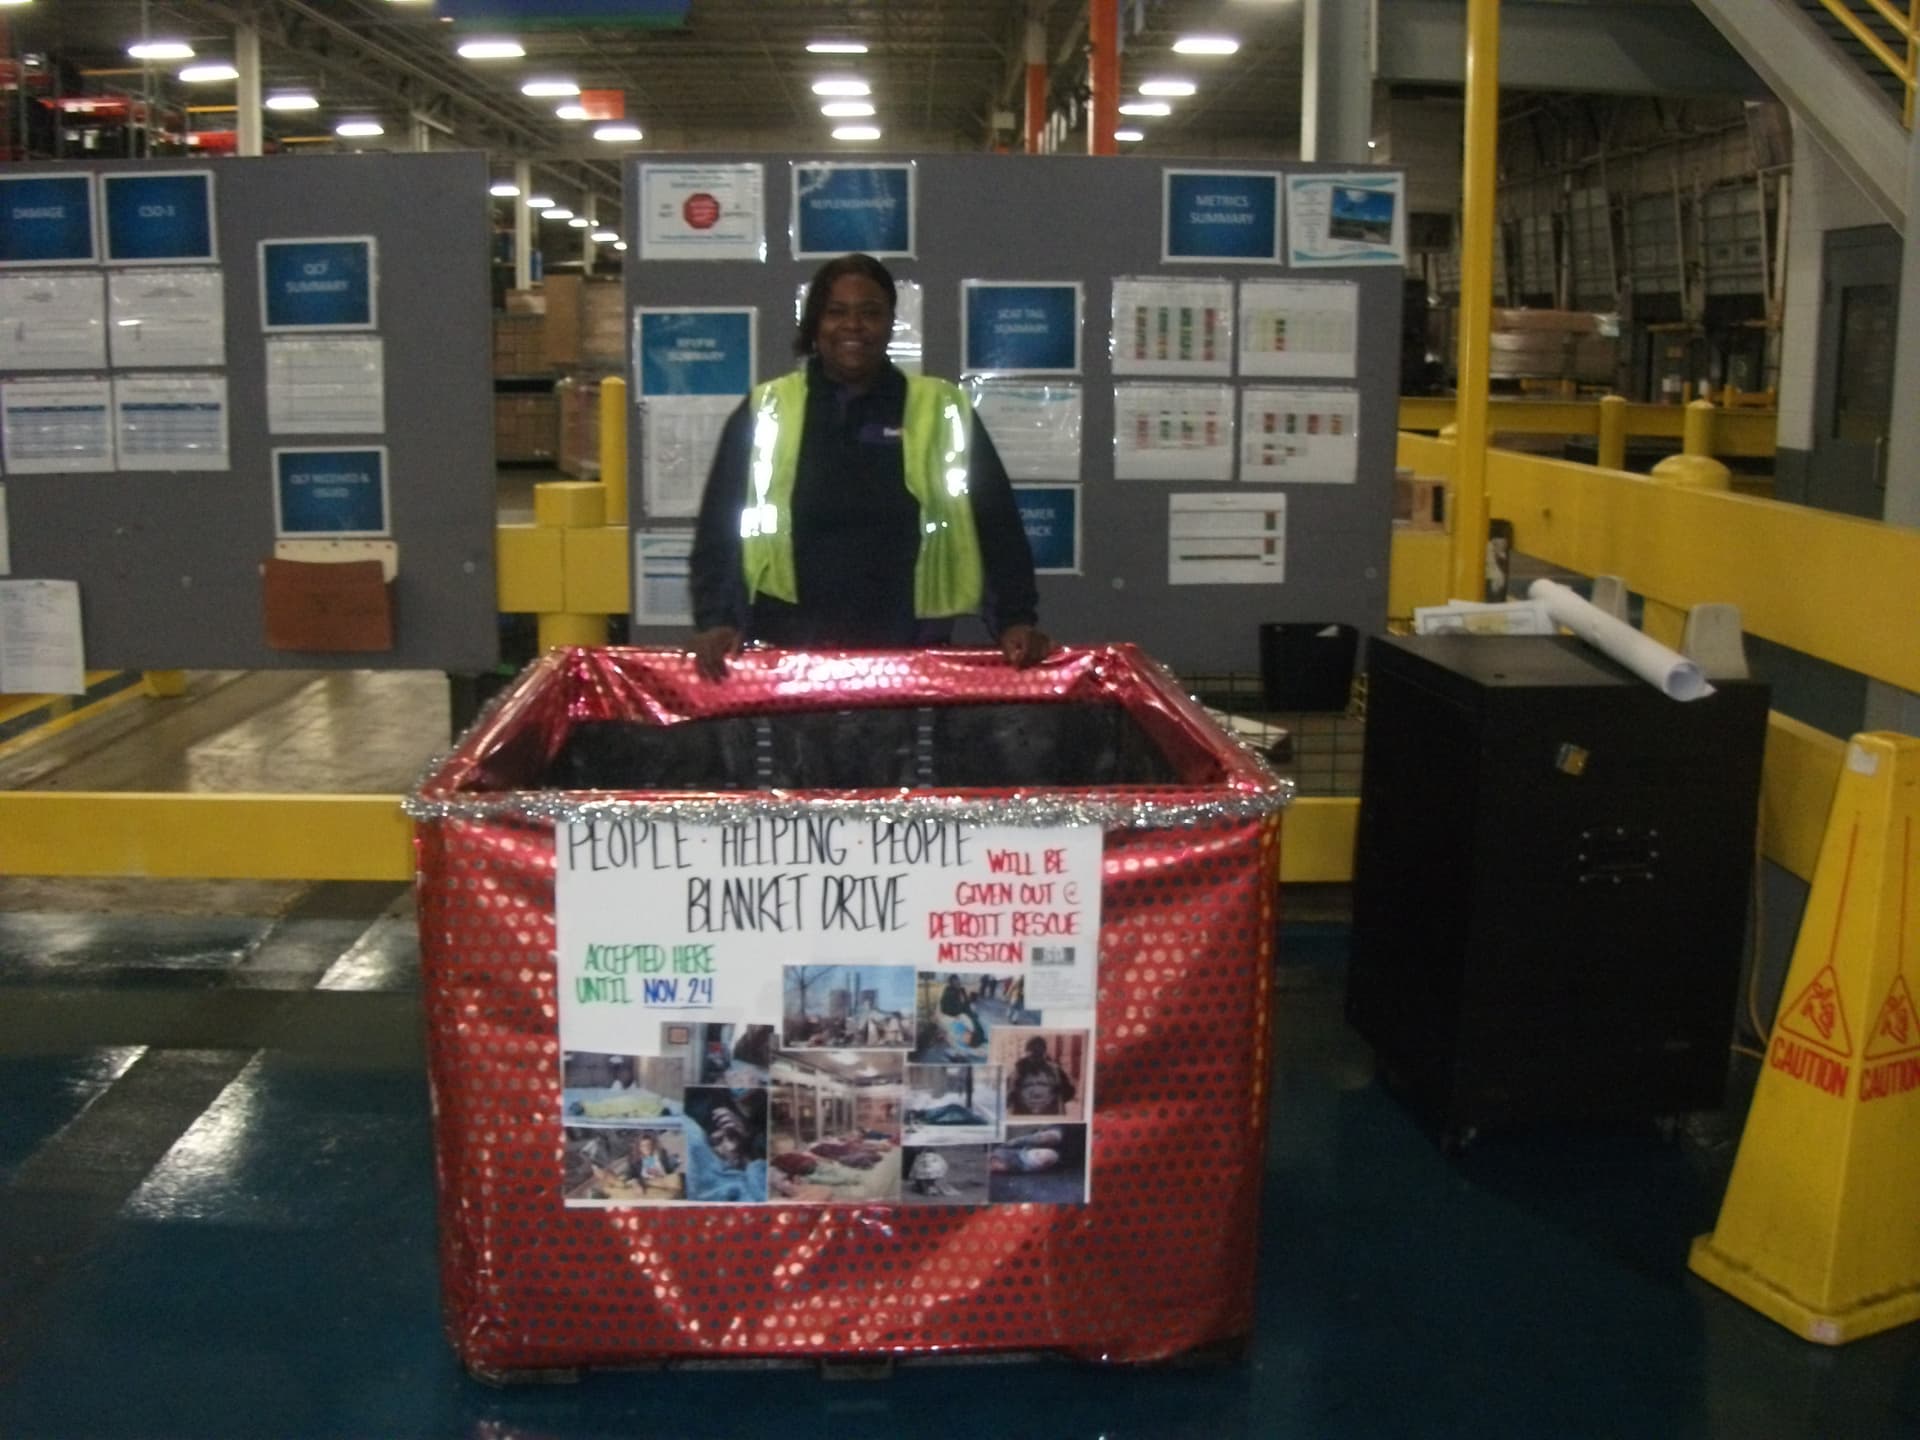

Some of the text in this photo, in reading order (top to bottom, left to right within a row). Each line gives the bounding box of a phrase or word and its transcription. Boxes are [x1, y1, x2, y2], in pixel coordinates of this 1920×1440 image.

[1194, 195, 1250, 207] METRICS
[1188, 212, 1256, 224] SUMMARY
[285, 280, 350, 294] SUMMARY
[568, 816, 973, 871] PEOPLE HELPING PEOPLE
[986, 848, 1071, 876] WILL BE
[686, 872, 909, 933] BLANKET DRIVE
[955, 881, 1013, 906] GIVEN
[1019, 881, 1056, 905] OUT
[928, 910, 1081, 939] DETROIT RESCUE
[584, 943, 718, 975] ACCEPTED HERE
[937, 942, 1024, 964] MISSION
[575, 976, 633, 1004] UNTIL
[687, 976, 713, 1004] 24
[1771, 1036, 1849, 1099] CAUTION
